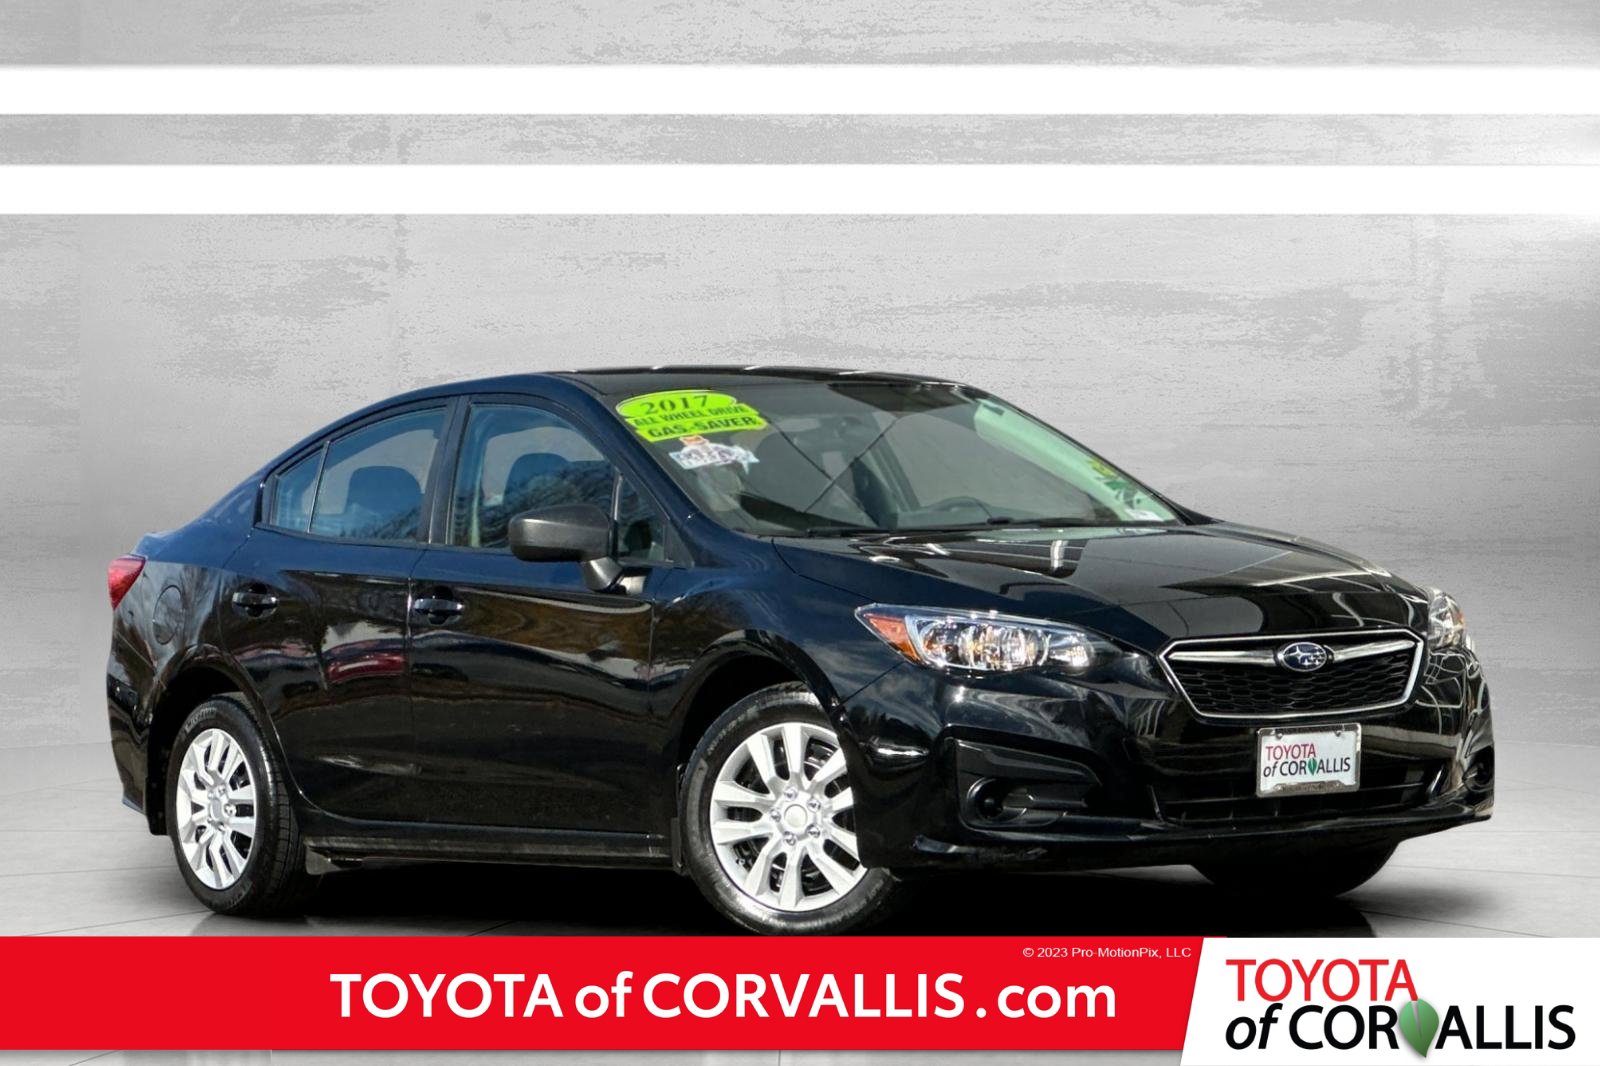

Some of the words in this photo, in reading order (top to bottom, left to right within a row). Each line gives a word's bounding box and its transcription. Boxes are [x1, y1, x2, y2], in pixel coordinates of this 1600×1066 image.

[639, 394, 709, 415] 2017
[633, 417, 658, 427] ALL
[661, 410, 705, 423] WHEEL
[707, 405, 751, 416] DRIVE
[1265, 743, 1317, 761] TOYOTA
[1263, 760, 1279, 778] of
